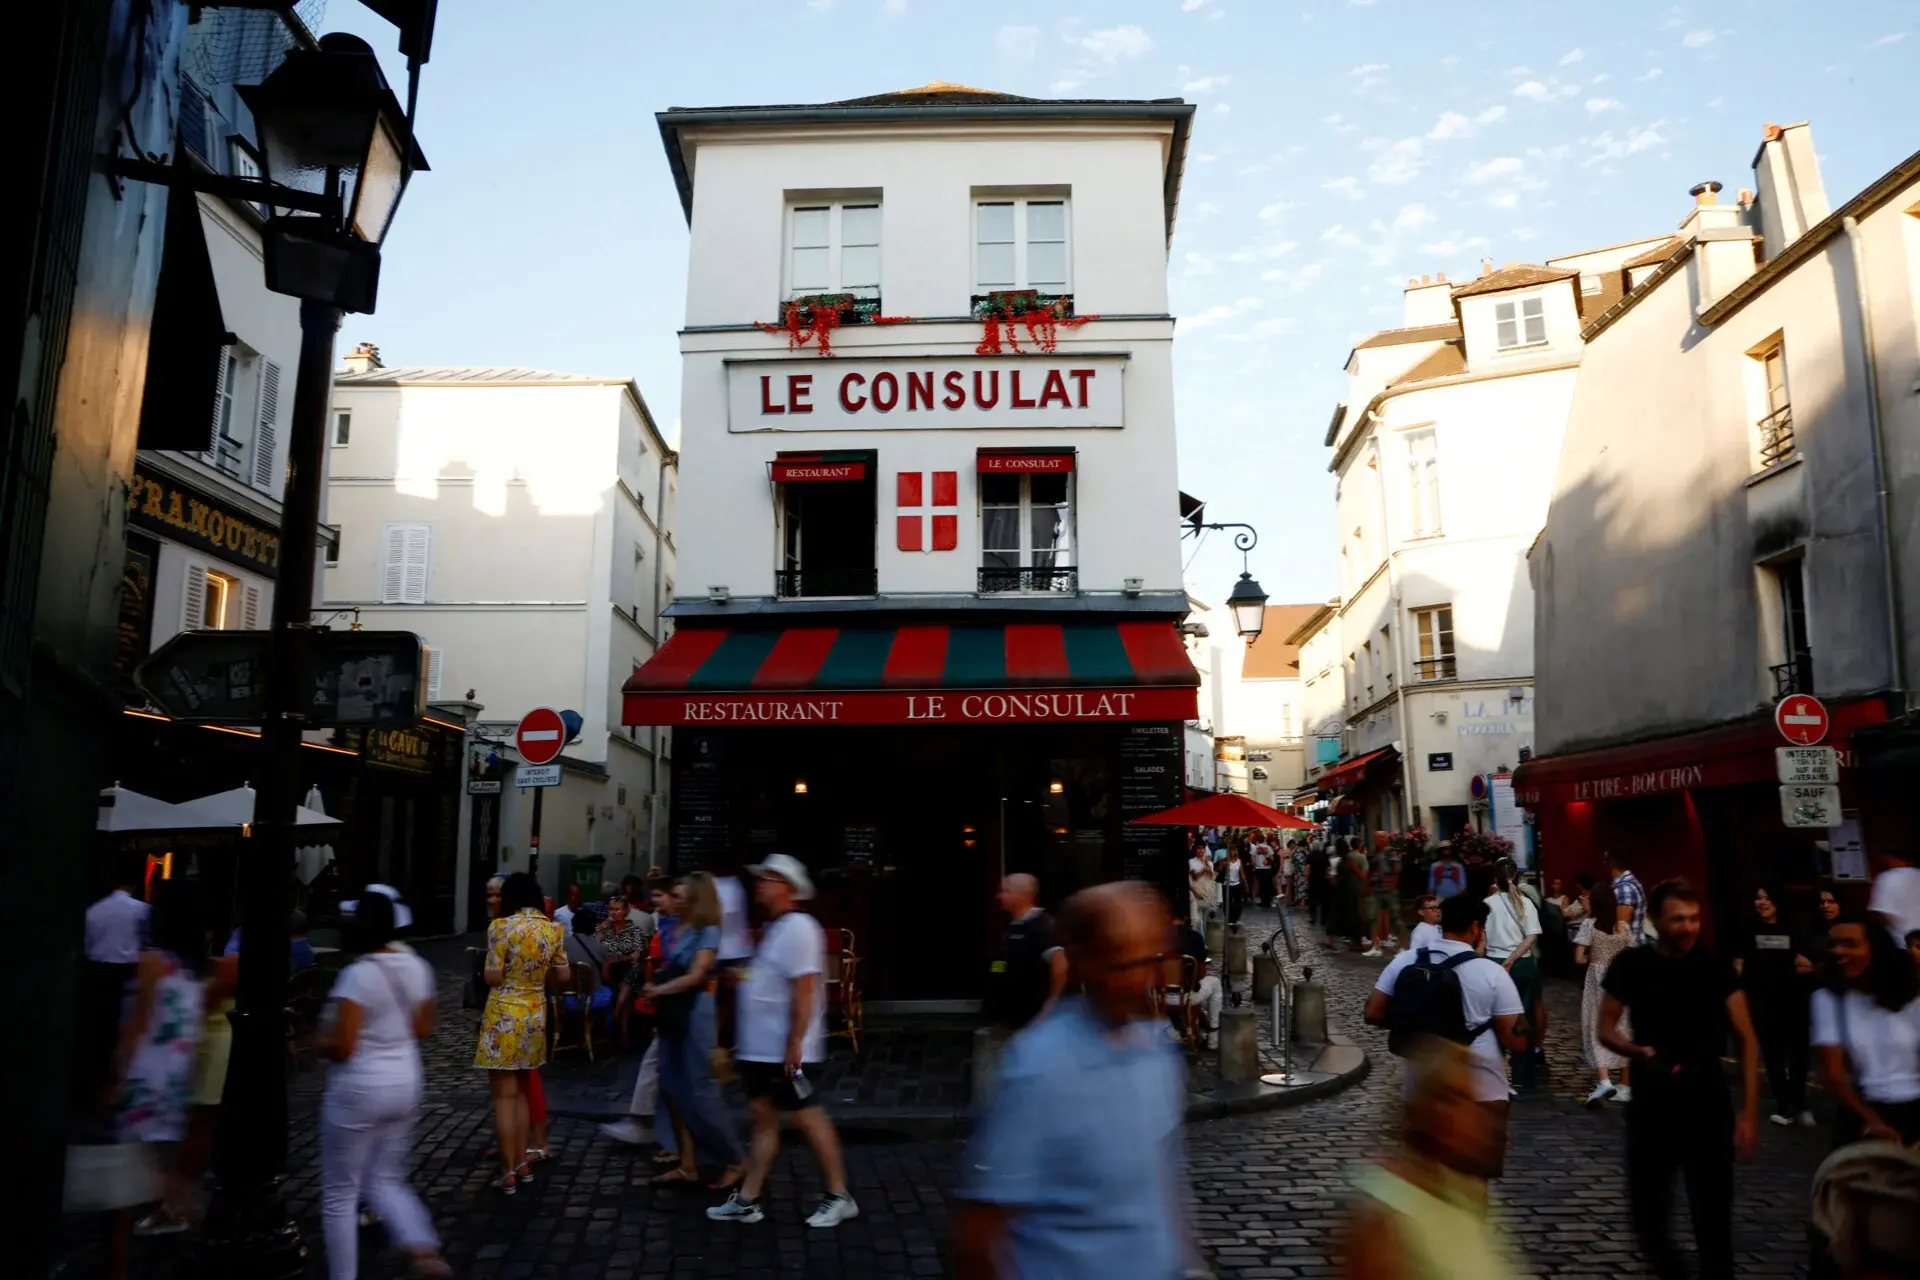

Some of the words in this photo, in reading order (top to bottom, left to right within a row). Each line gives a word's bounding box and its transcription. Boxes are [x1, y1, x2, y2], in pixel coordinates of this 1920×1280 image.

[760, 374, 814, 414] LE
[839, 369, 1097, 412] CONSULAT
[988, 459, 1002, 469] LE
[1005, 458, 1062, 469] CONSULAT
[785, 466, 852, 479] RESTAURANT
[683, 701, 843, 721] RESTAURANT
[906, 695, 946, 719] LE
[961, 693, 1136, 719] CONSULAT
[1785, 749, 1827, 758] INTERDIT
[1134, 765, 1165, 773] SALADES
[1574, 780, 1591, 800] LE
[1592, 777, 1623, 798] TIRE
[1631, 764, 1705, 794] BOUCHON
[1794, 787, 1825, 798] SAUF
